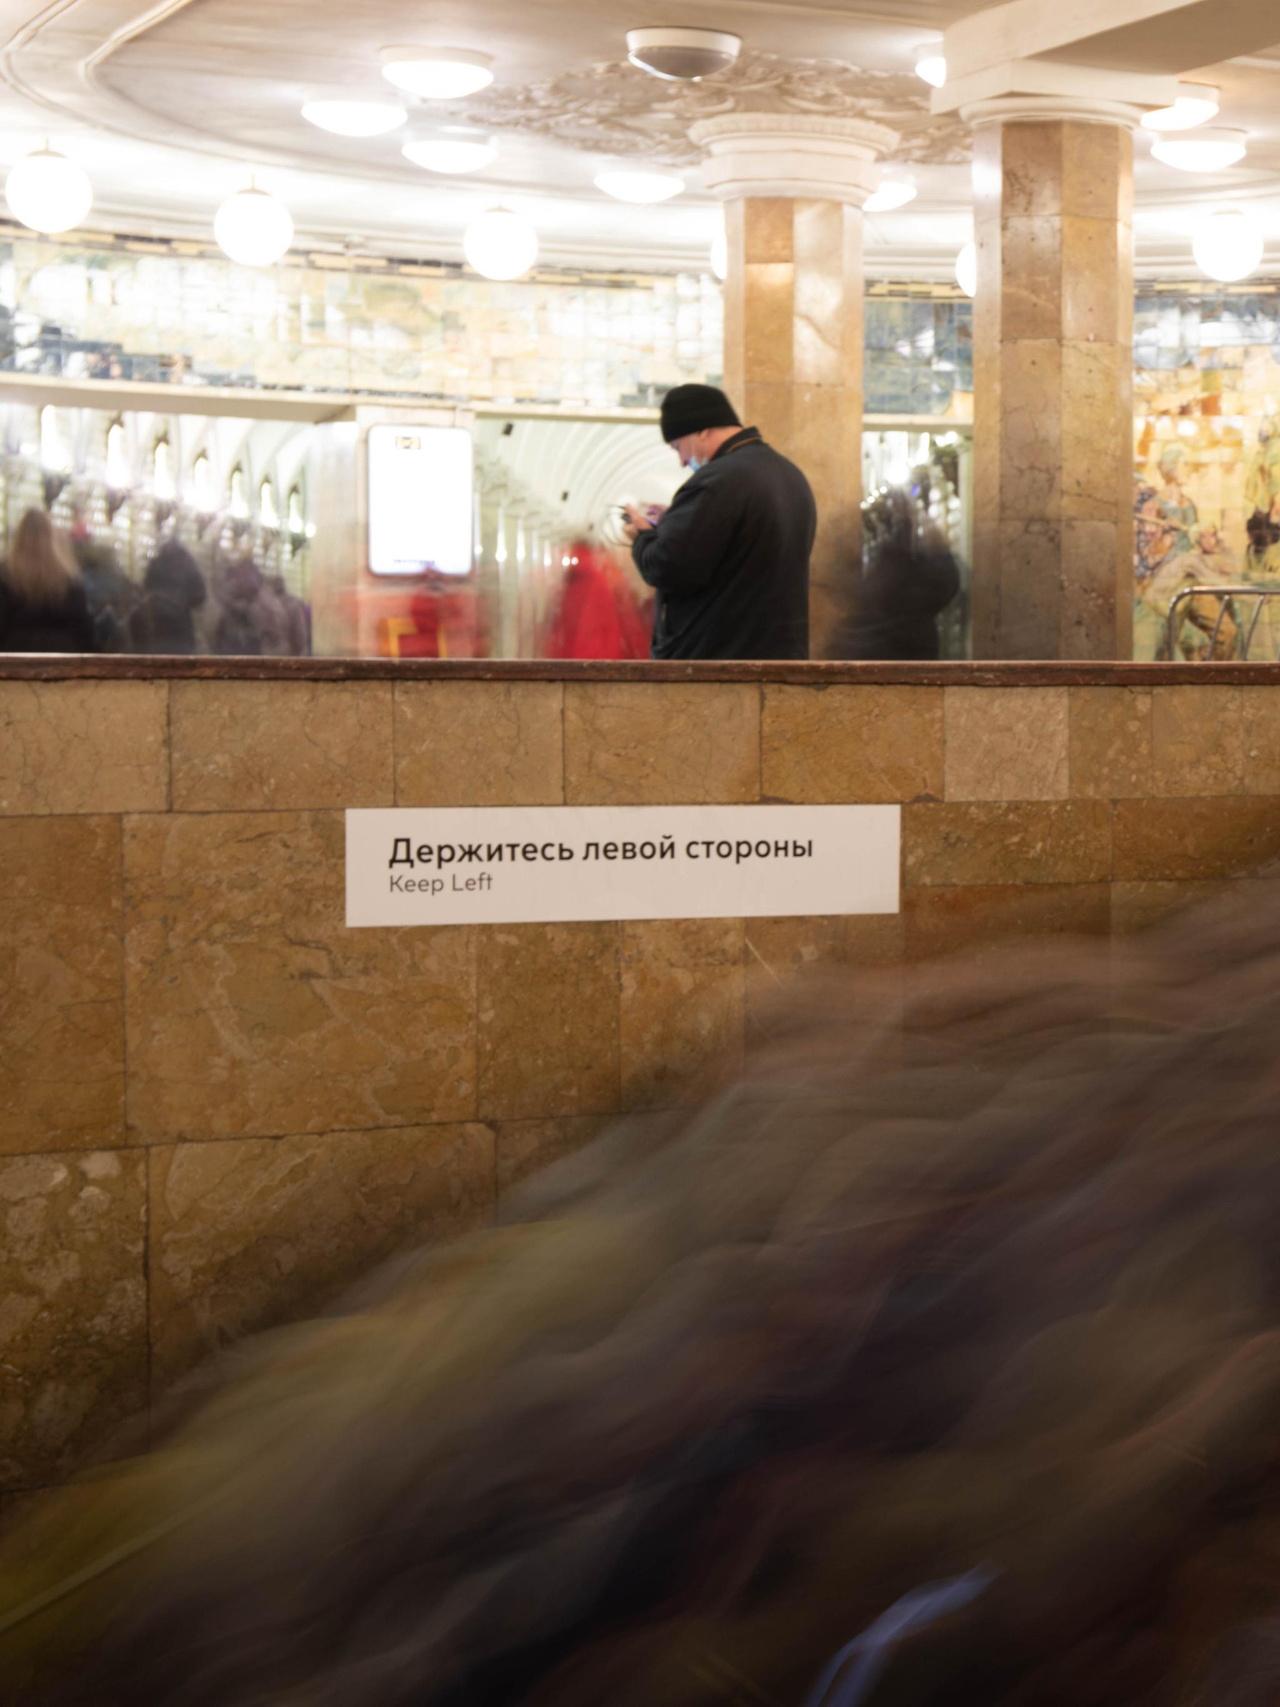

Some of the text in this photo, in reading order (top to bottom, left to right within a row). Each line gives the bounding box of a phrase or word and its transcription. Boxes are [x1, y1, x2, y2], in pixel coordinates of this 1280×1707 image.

[388, 834, 813, 869] Держитесь левой стороны
[388, 872, 494, 895] Keep Left
